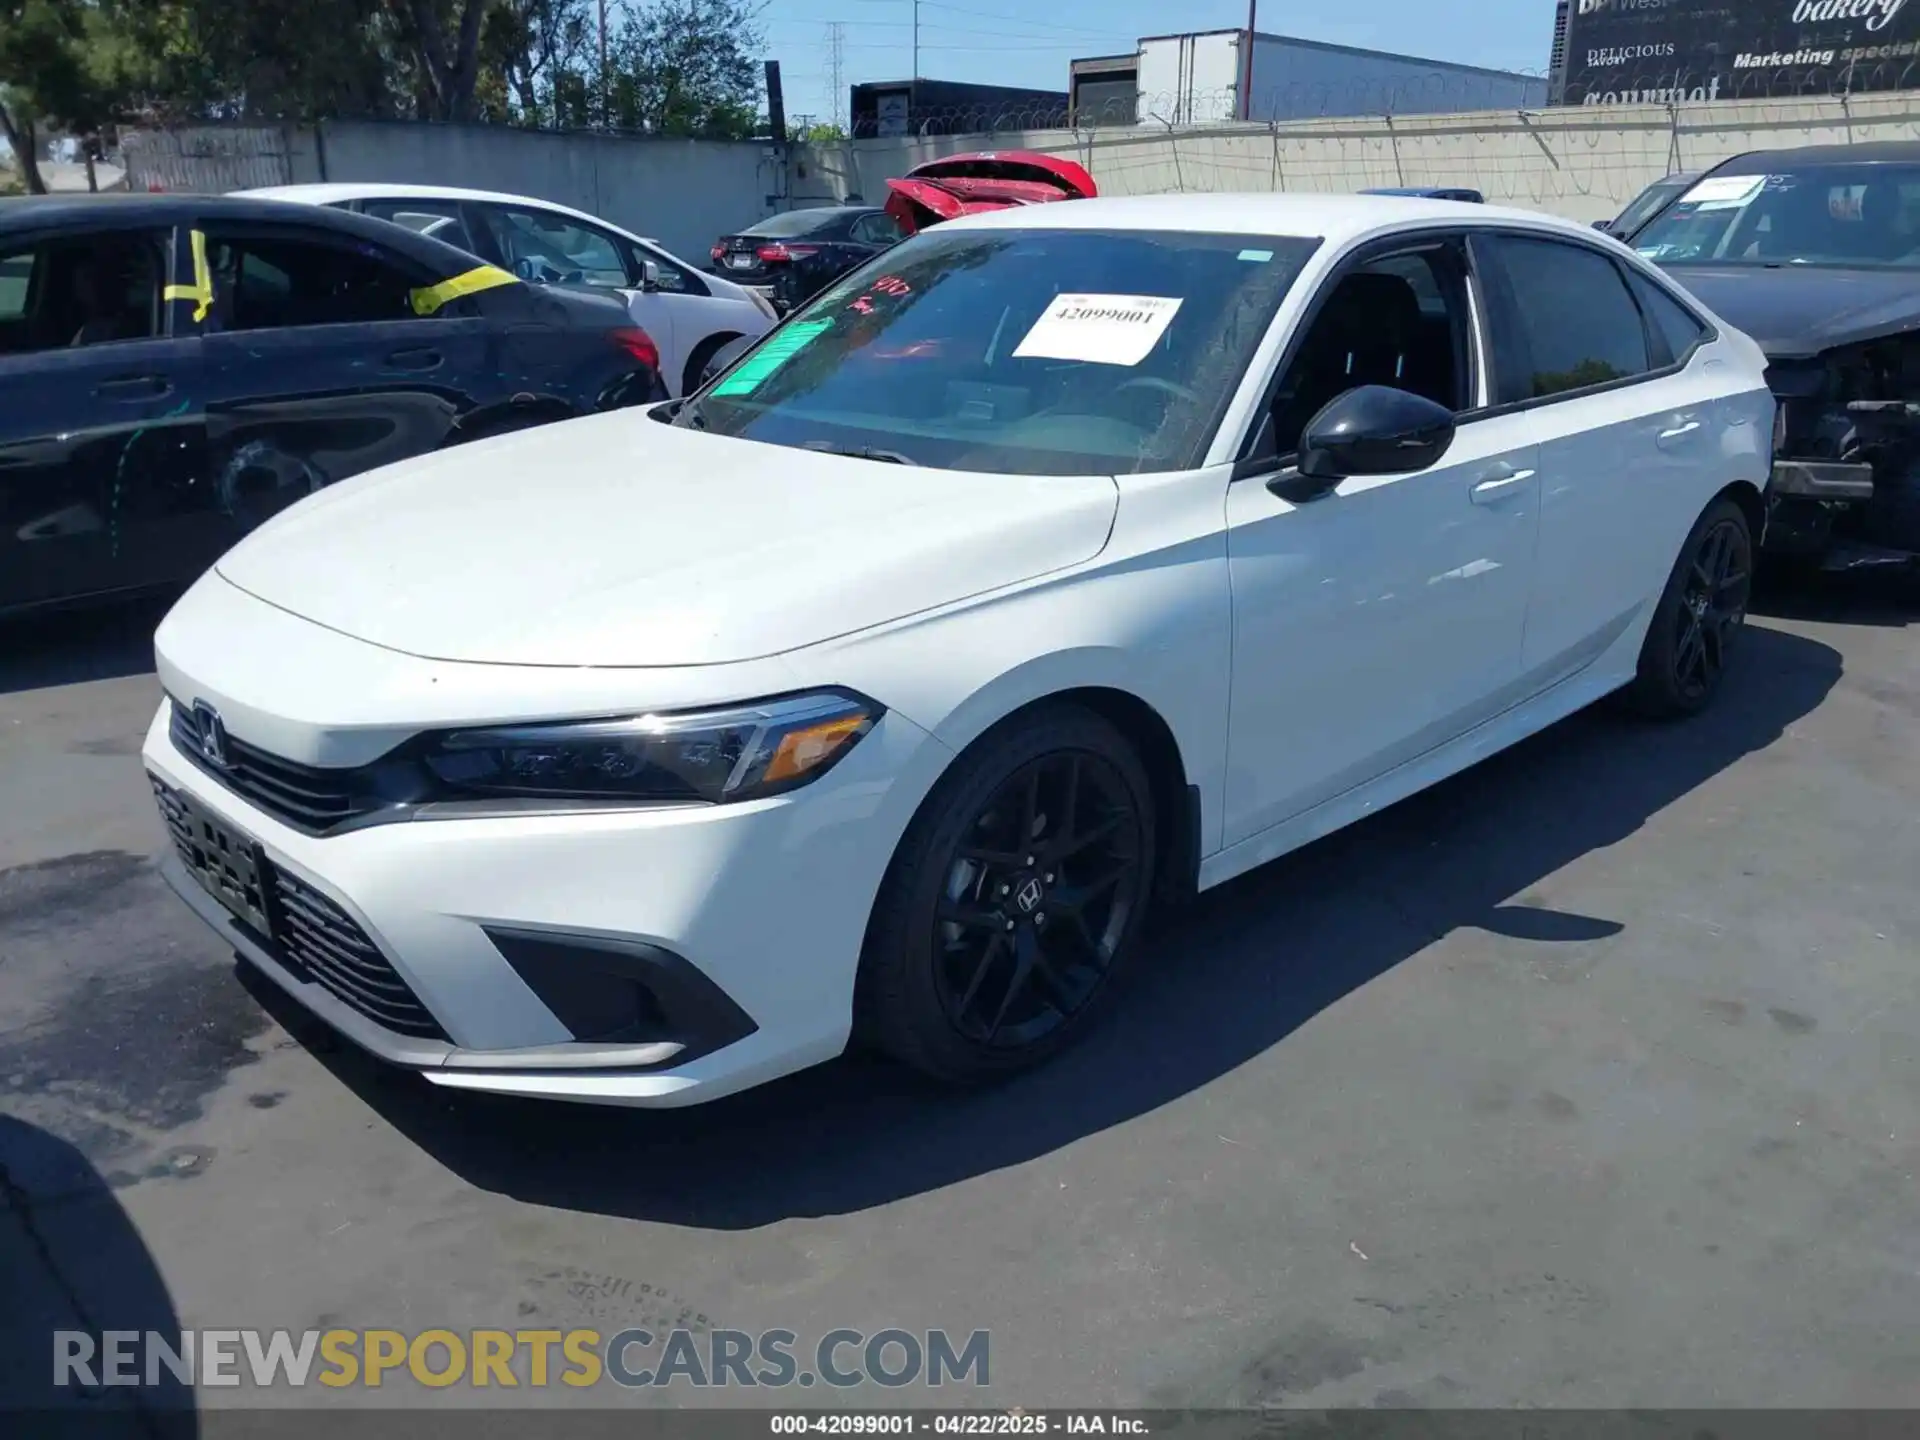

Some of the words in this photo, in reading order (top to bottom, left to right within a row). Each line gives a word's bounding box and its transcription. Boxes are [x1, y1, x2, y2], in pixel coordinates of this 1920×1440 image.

[1791, 0, 1908, 32] bakery
[1587, 42, 1675, 61] DELICIOUS
[1733, 49, 1834, 69] Marketing
[1055, 307, 1155, 324] 42099001
